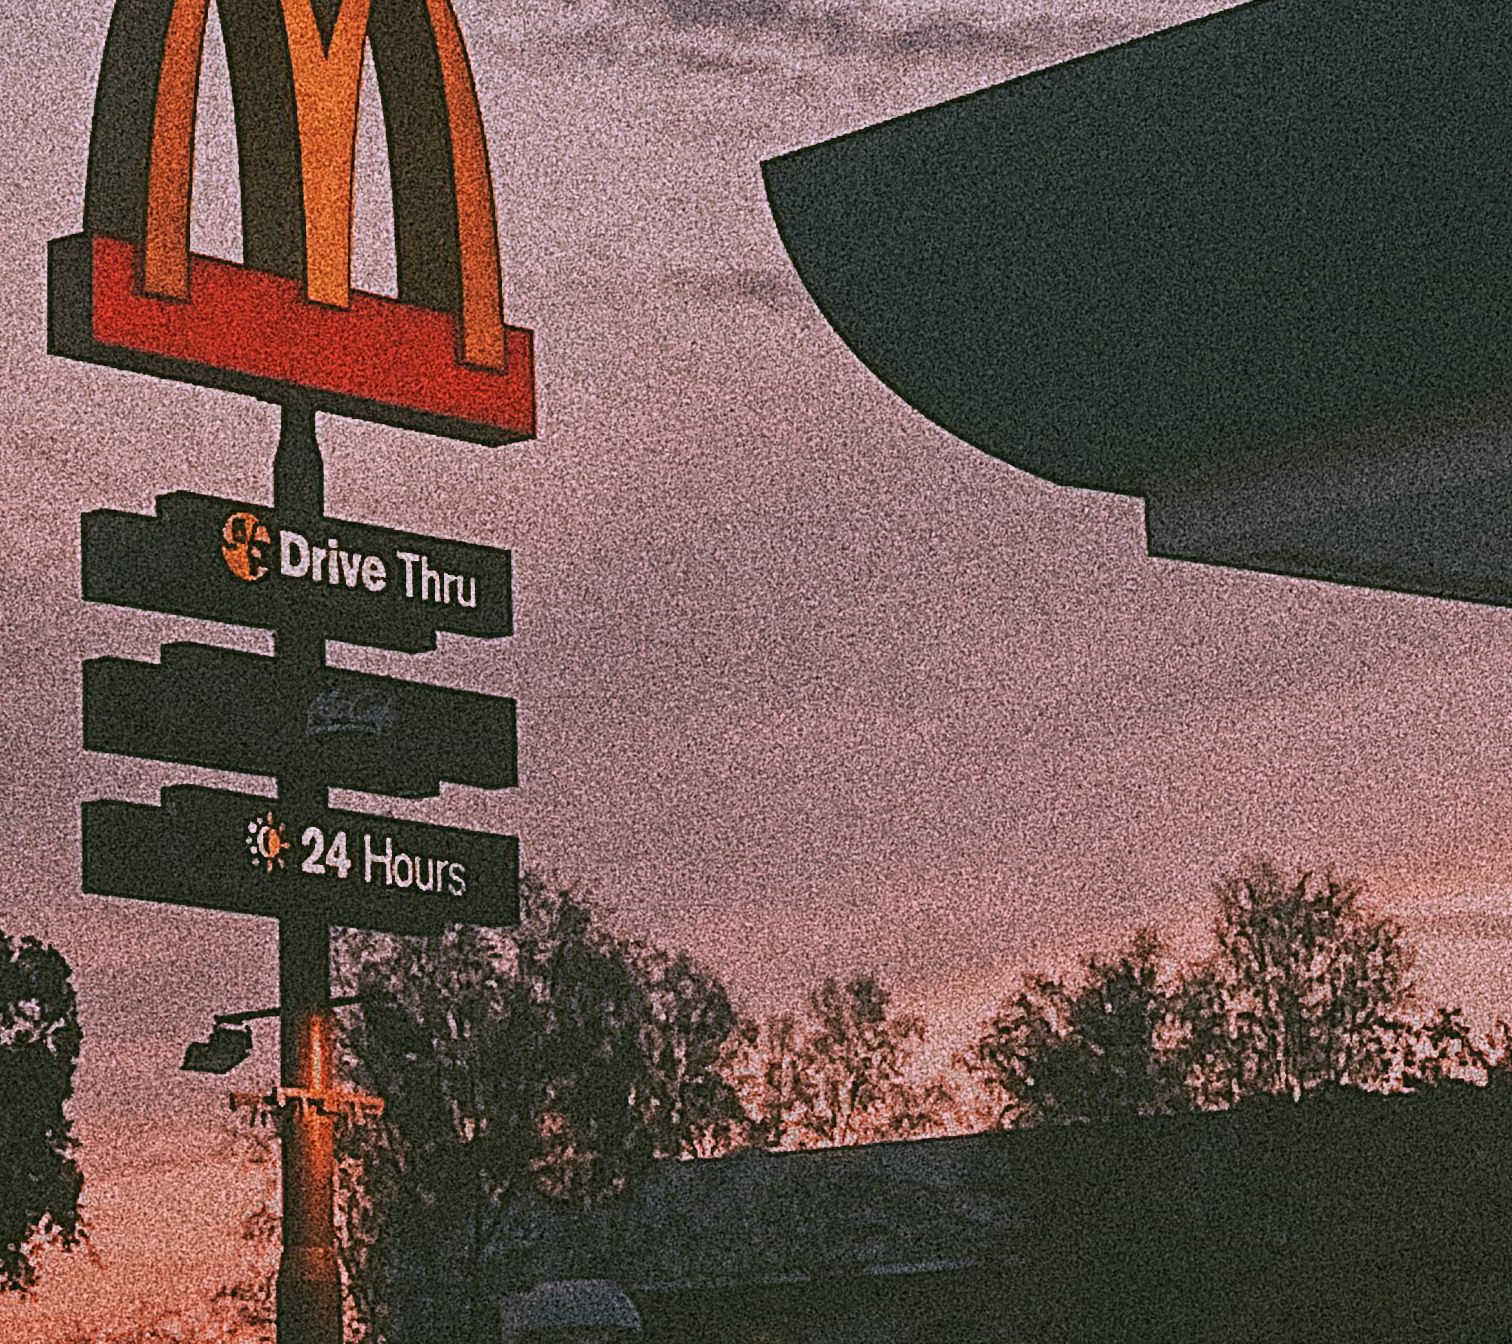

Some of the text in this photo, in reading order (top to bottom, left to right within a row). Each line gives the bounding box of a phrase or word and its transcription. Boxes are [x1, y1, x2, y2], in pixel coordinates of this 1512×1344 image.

[280, 531, 477, 608] Drive Thru
[301, 826, 466, 896] 24 Hours
